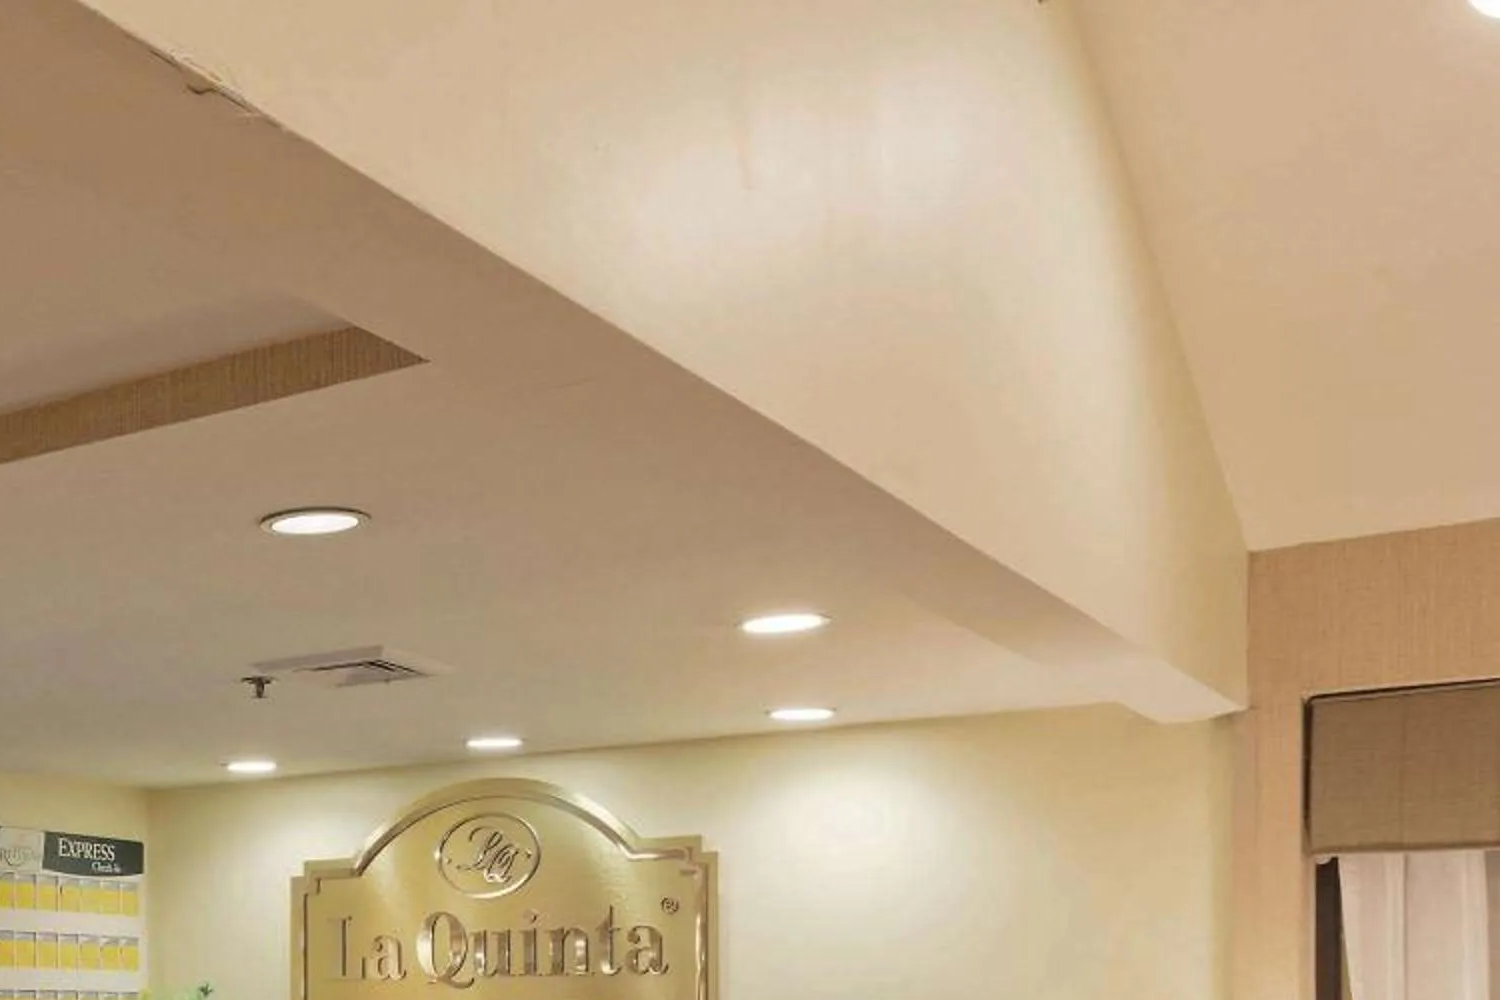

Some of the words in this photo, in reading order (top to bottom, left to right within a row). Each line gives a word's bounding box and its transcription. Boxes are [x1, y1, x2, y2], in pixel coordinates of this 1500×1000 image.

[58, 837, 115, 862] EXPRESS
[327, 916, 406, 981] La
[416, 905, 669, 989] Quinta
